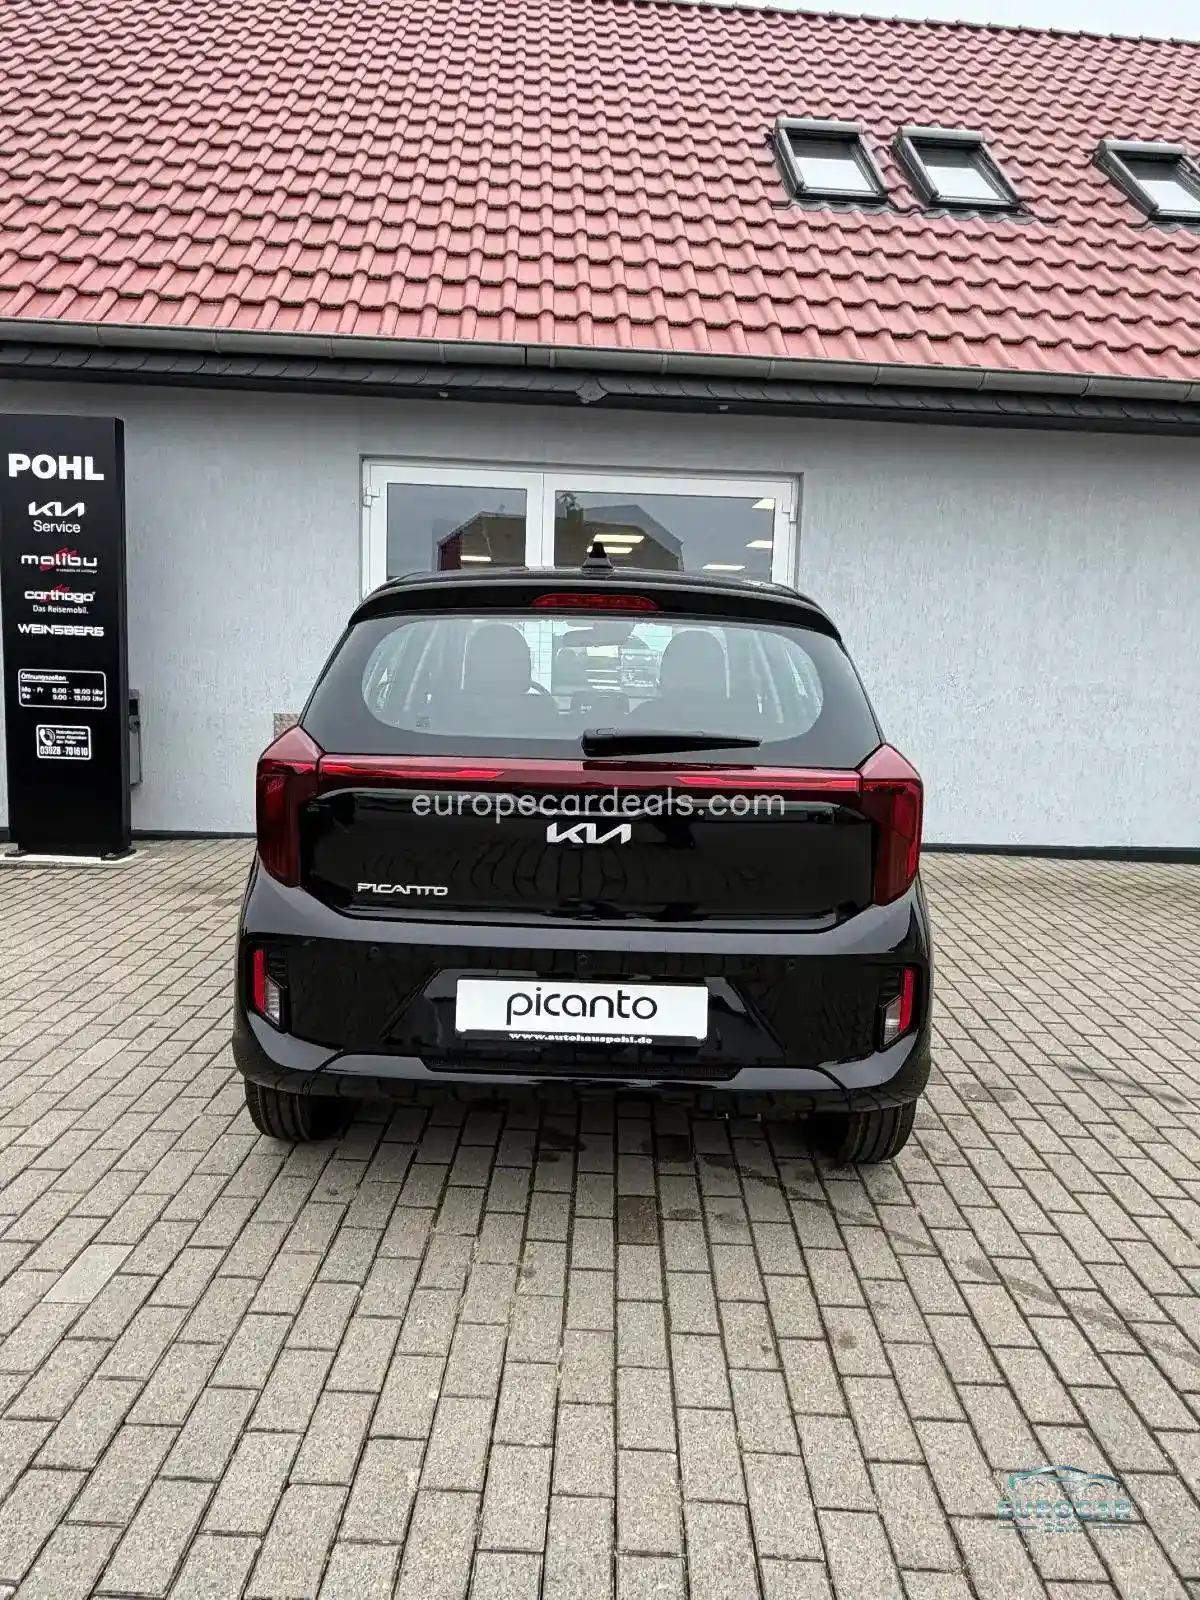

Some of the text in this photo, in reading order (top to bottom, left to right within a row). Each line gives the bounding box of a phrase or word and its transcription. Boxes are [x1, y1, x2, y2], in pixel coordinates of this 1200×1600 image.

[8, 453, 104, 481] POHL
[28, 501, 85, 517] KIA
[33, 519, 81, 534] Service
[21, 553, 98, 567] malibu
[32, 604, 46, 613] Das
[546, 822, 632, 844] KIA
[357, 882, 448, 896] PICANTO
[506, 986, 658, 1025] picanto
[508, 1032, 653, 1045] www.autohauspohl.de
